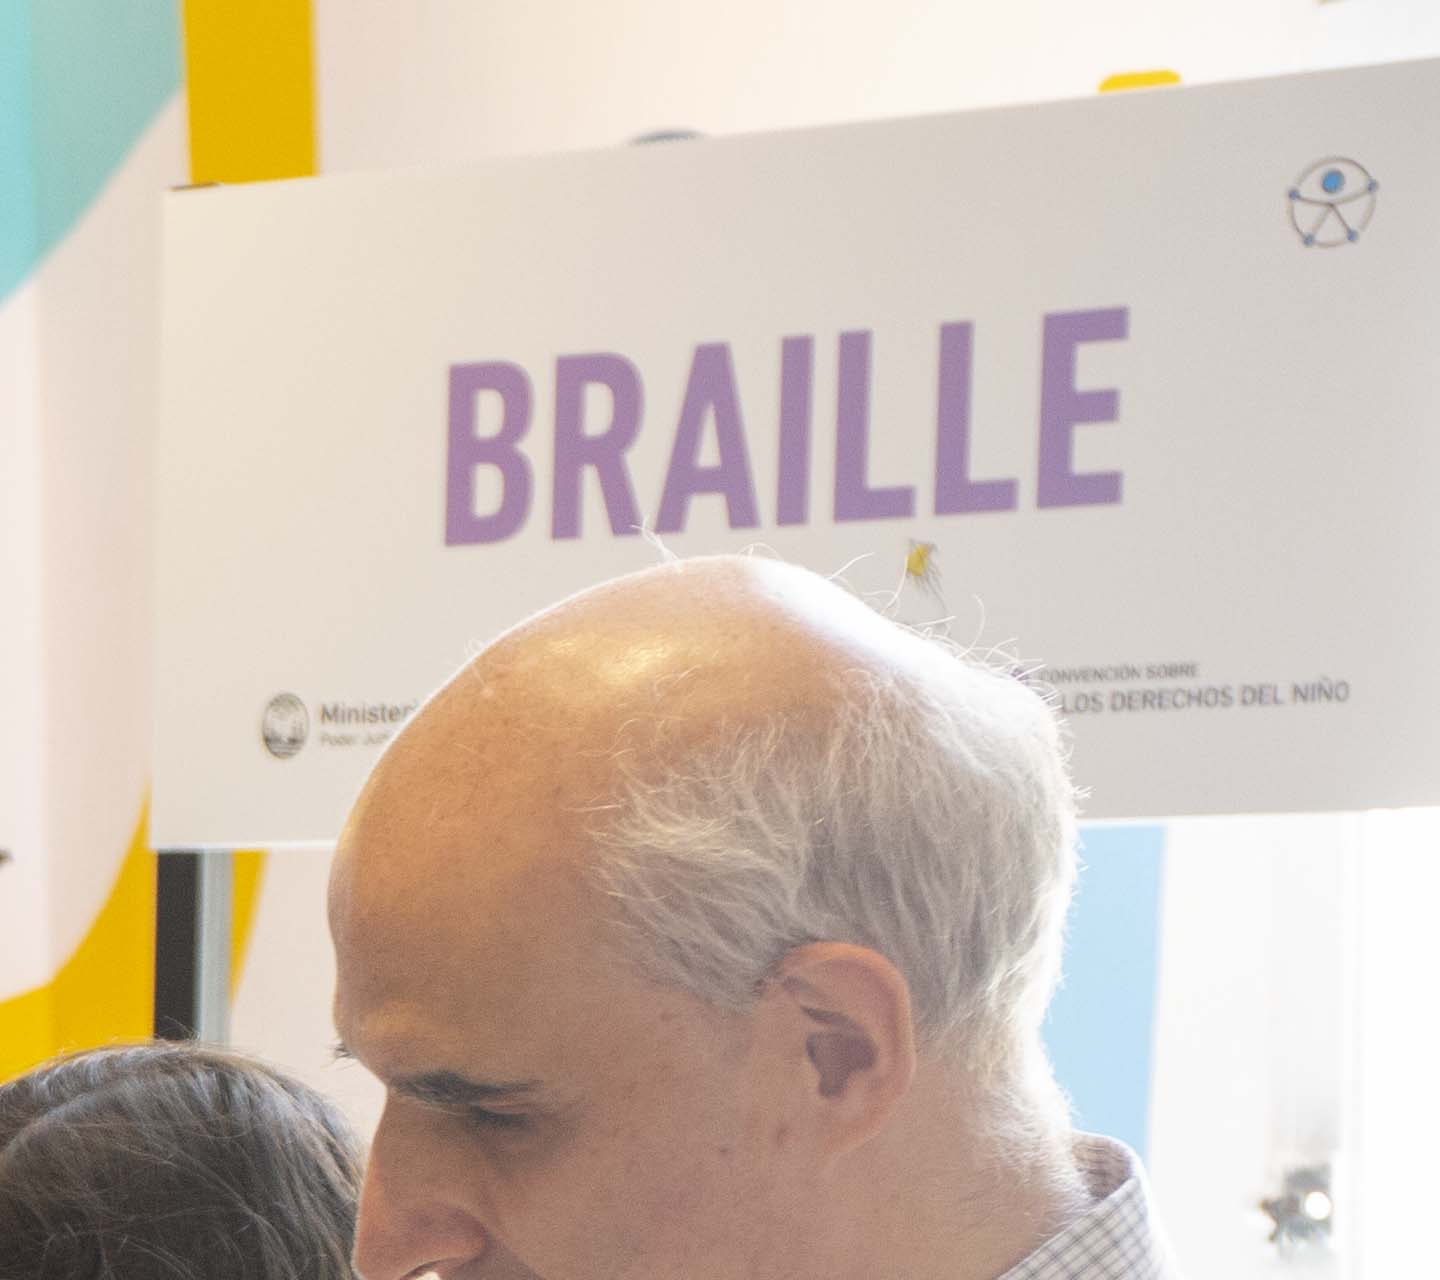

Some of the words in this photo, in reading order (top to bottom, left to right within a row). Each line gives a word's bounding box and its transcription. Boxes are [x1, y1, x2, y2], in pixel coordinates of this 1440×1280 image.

[443, 306, 1130, 547] BRAILLE
[1146, 661, 1200, 680] SOBRE
[1062, 690, 1104, 715] LOS
[1110, 684, 1234, 713] DERECHOS
[1239, 682, 1284, 706] DEL
[1292, 675, 1351, 704] NIÑO
